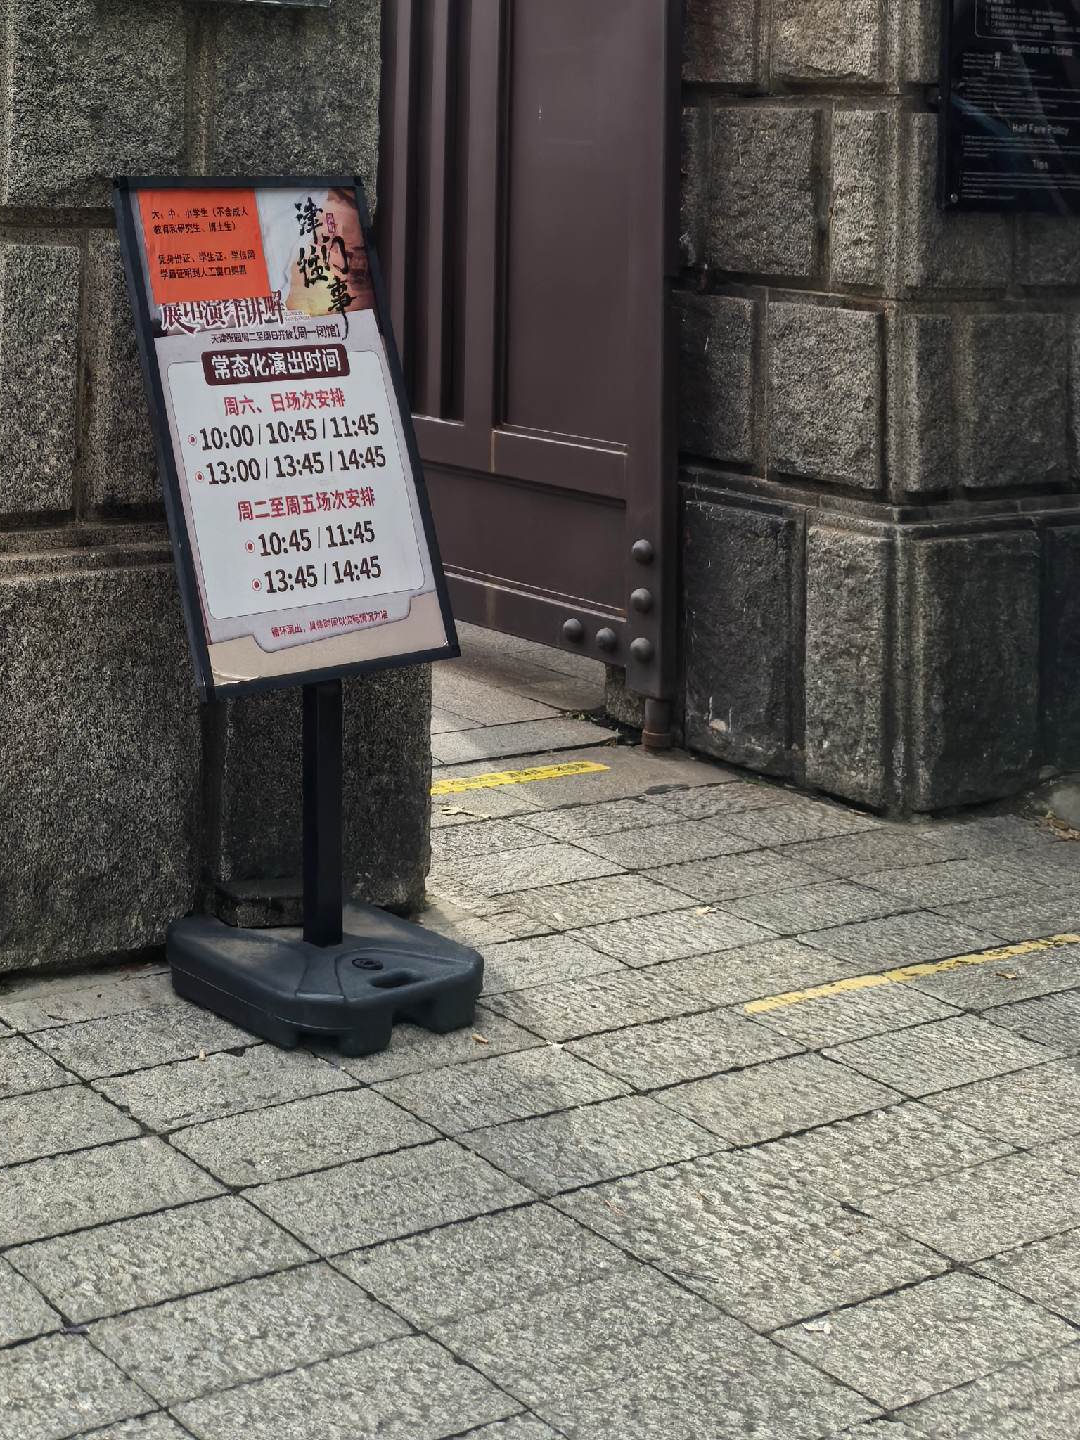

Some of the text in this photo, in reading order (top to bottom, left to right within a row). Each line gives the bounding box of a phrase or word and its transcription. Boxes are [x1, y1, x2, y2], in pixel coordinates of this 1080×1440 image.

[211, 348, 342, 380] 常态化演出时间
[223, 387, 346, 417] 周六、日场次安排
[199, 413, 380, 451] 10:00 10:45 11:45
[206, 445, 386, 485] 13:00 13:45 14:45
[237, 486, 376, 523] 周二至周五场次安排
[258, 520, 376, 557] 10:45 11:45
[264, 555, 382, 594] 13:45 14:45
